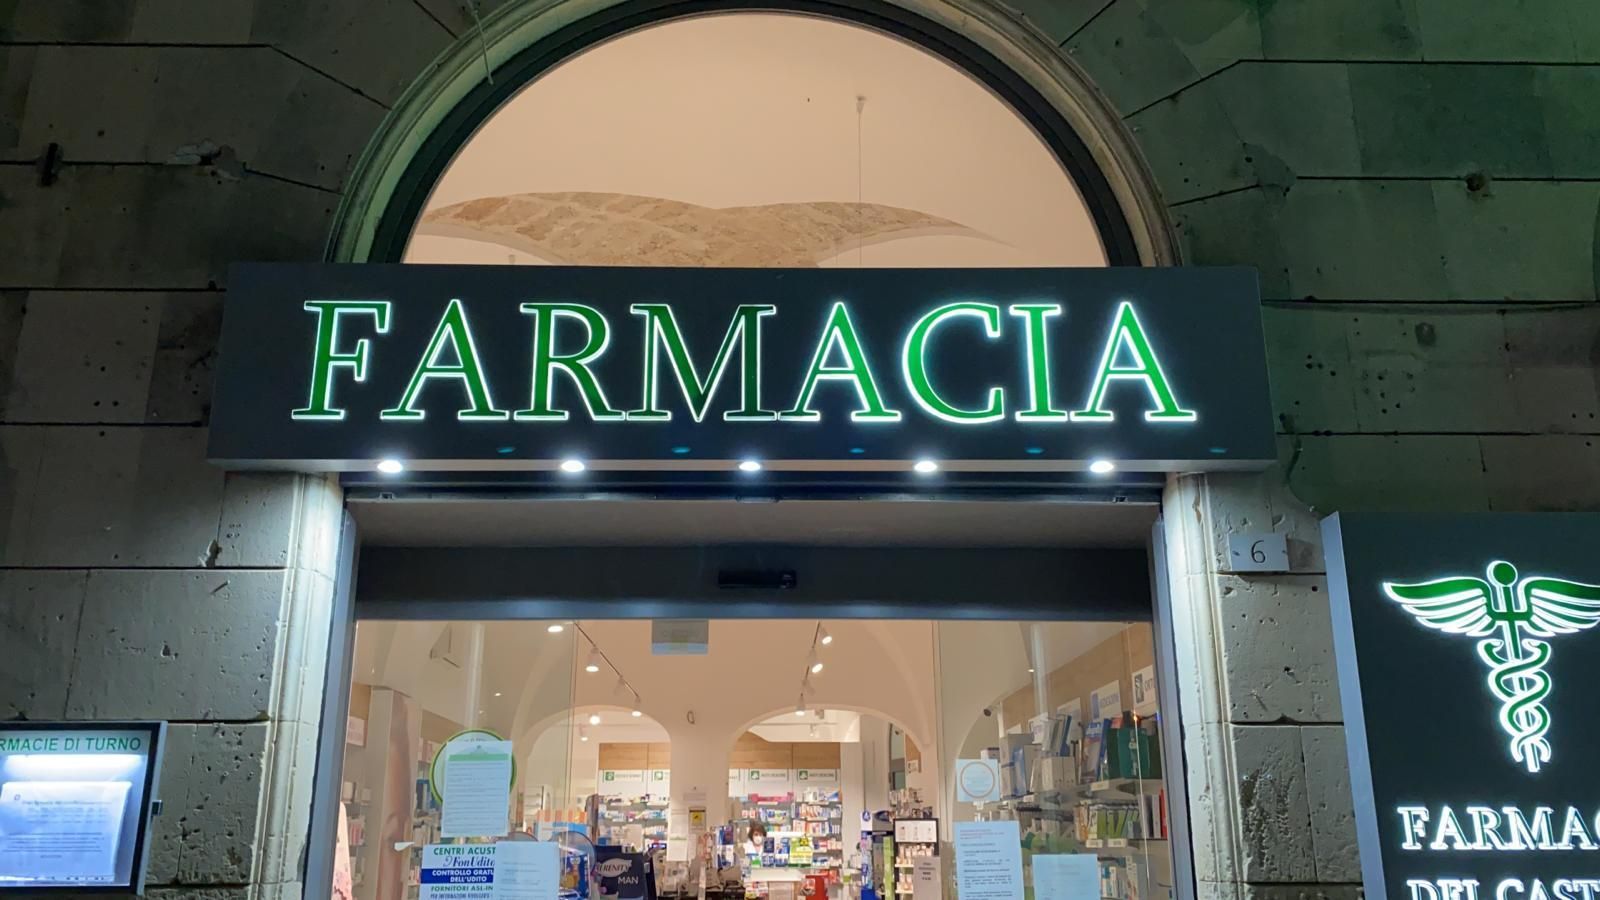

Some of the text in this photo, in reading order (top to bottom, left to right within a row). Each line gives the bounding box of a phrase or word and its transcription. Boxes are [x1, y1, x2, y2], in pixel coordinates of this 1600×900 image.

[291, 297, 1198, 424] FARMACIA
[1250, 540, 1267, 564] 6
[0, 737, 141, 751] RMACIE DI TURNO
[1396, 805, 1600, 850] FARMA
[433, 846, 496, 856] CENTRI ACUST
[617, 876, 639, 885] MAN
